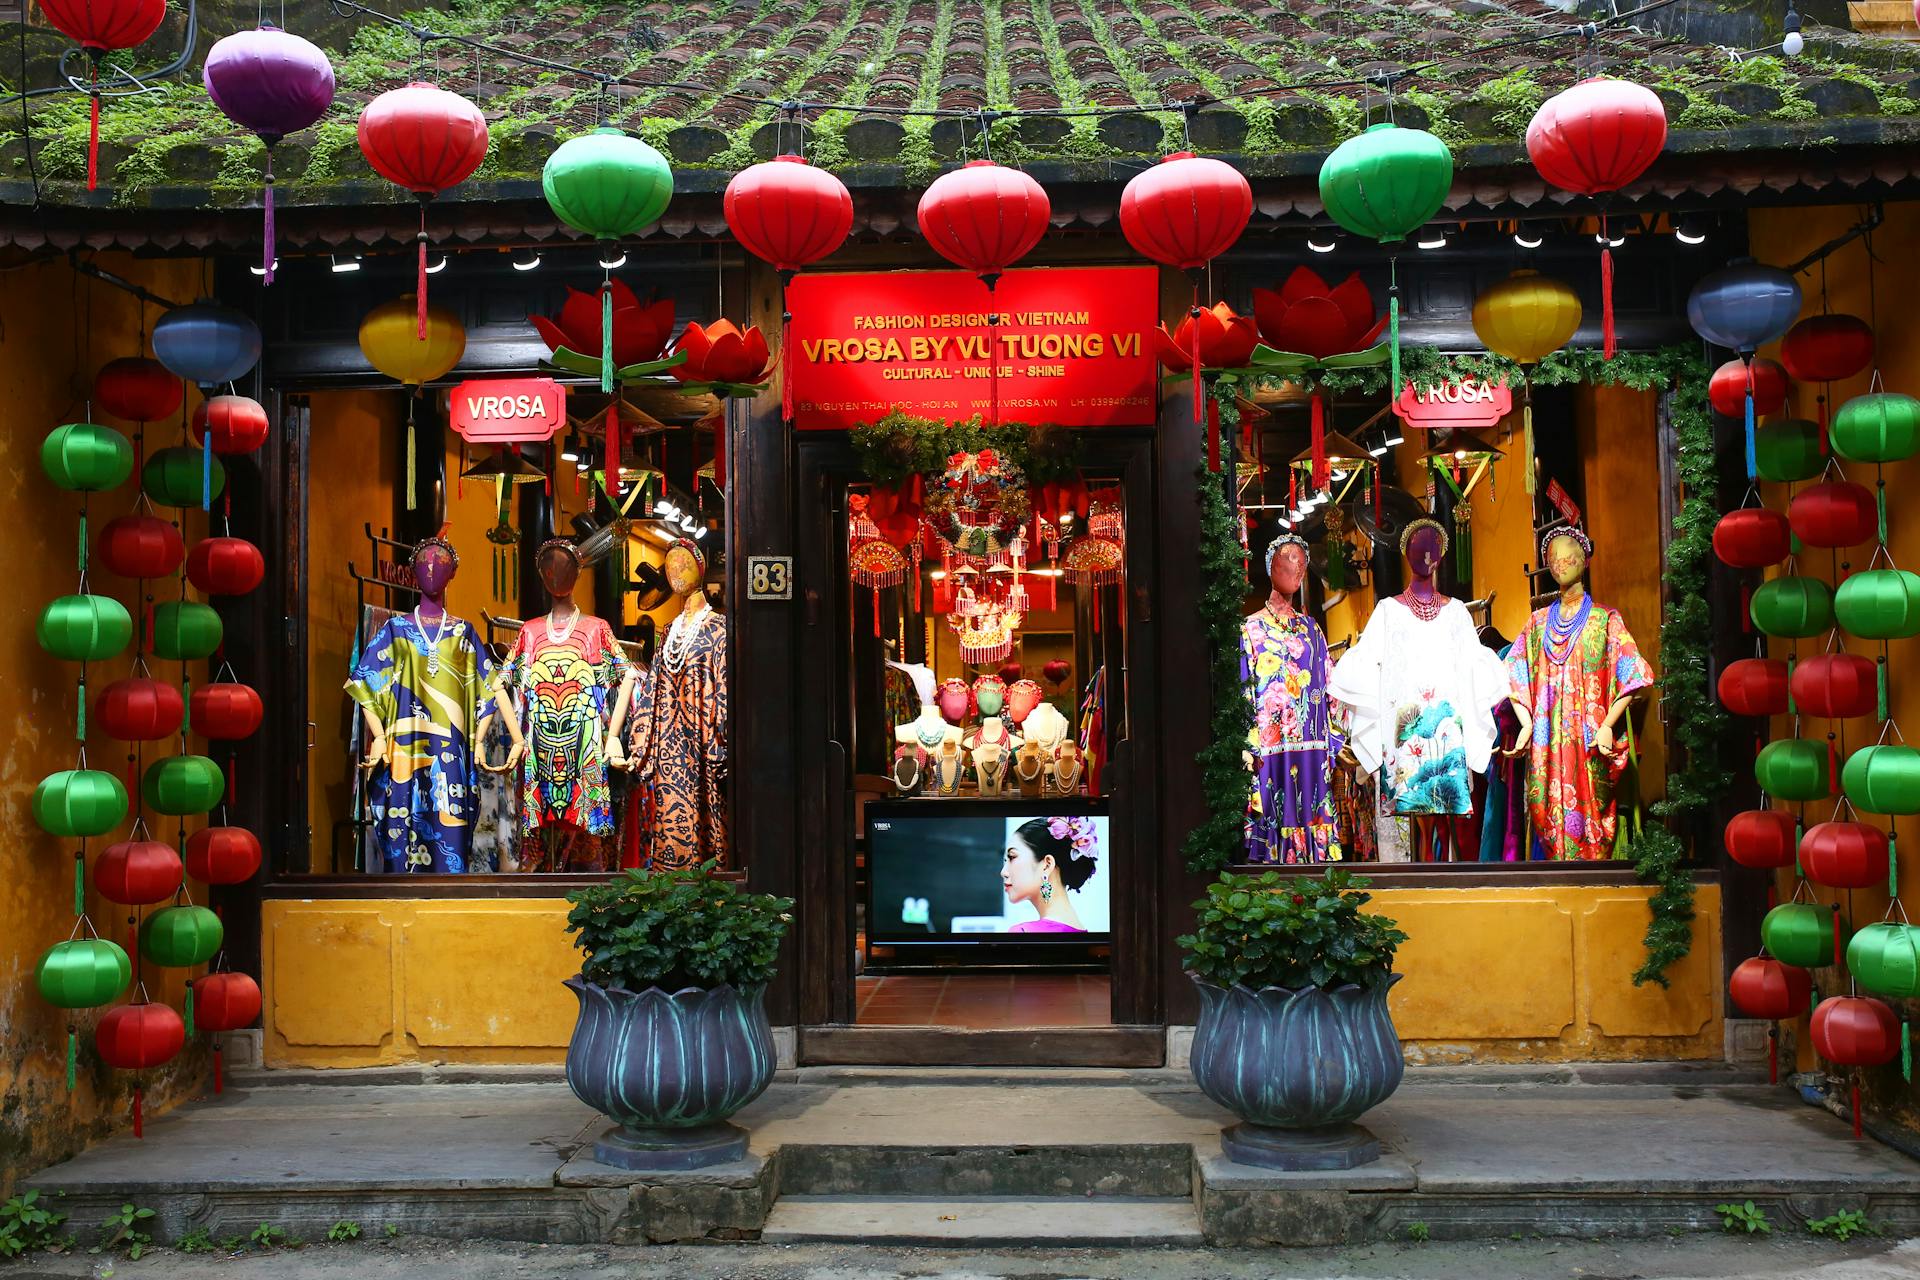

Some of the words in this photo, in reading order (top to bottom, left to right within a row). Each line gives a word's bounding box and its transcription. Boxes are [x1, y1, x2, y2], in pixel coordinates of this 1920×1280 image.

[854, 315, 924, 329] FASHION
[930, 313, 1011, 327] DESIGNR
[1016, 311, 1089, 326] VIETNAM
[802, 337, 904, 362] VROSA
[911, 336, 949, 360] BY
[1002, 333, 1104, 358] TUONG
[1113, 332, 1140, 357] VI
[882, 366, 952, 380] CULTURAL
[1027, 365, 1065, 378] SHINE
[467, 395, 547, 420] VROSA
[815, 402, 859, 411] NGUYEN
[862, 401, 887, 410] THAI
[890, 400, 912, 409] HOC
[921, 400, 940, 409] HOI
[942, 400, 958, 409] AN
[753, 562, 787, 593] 83
